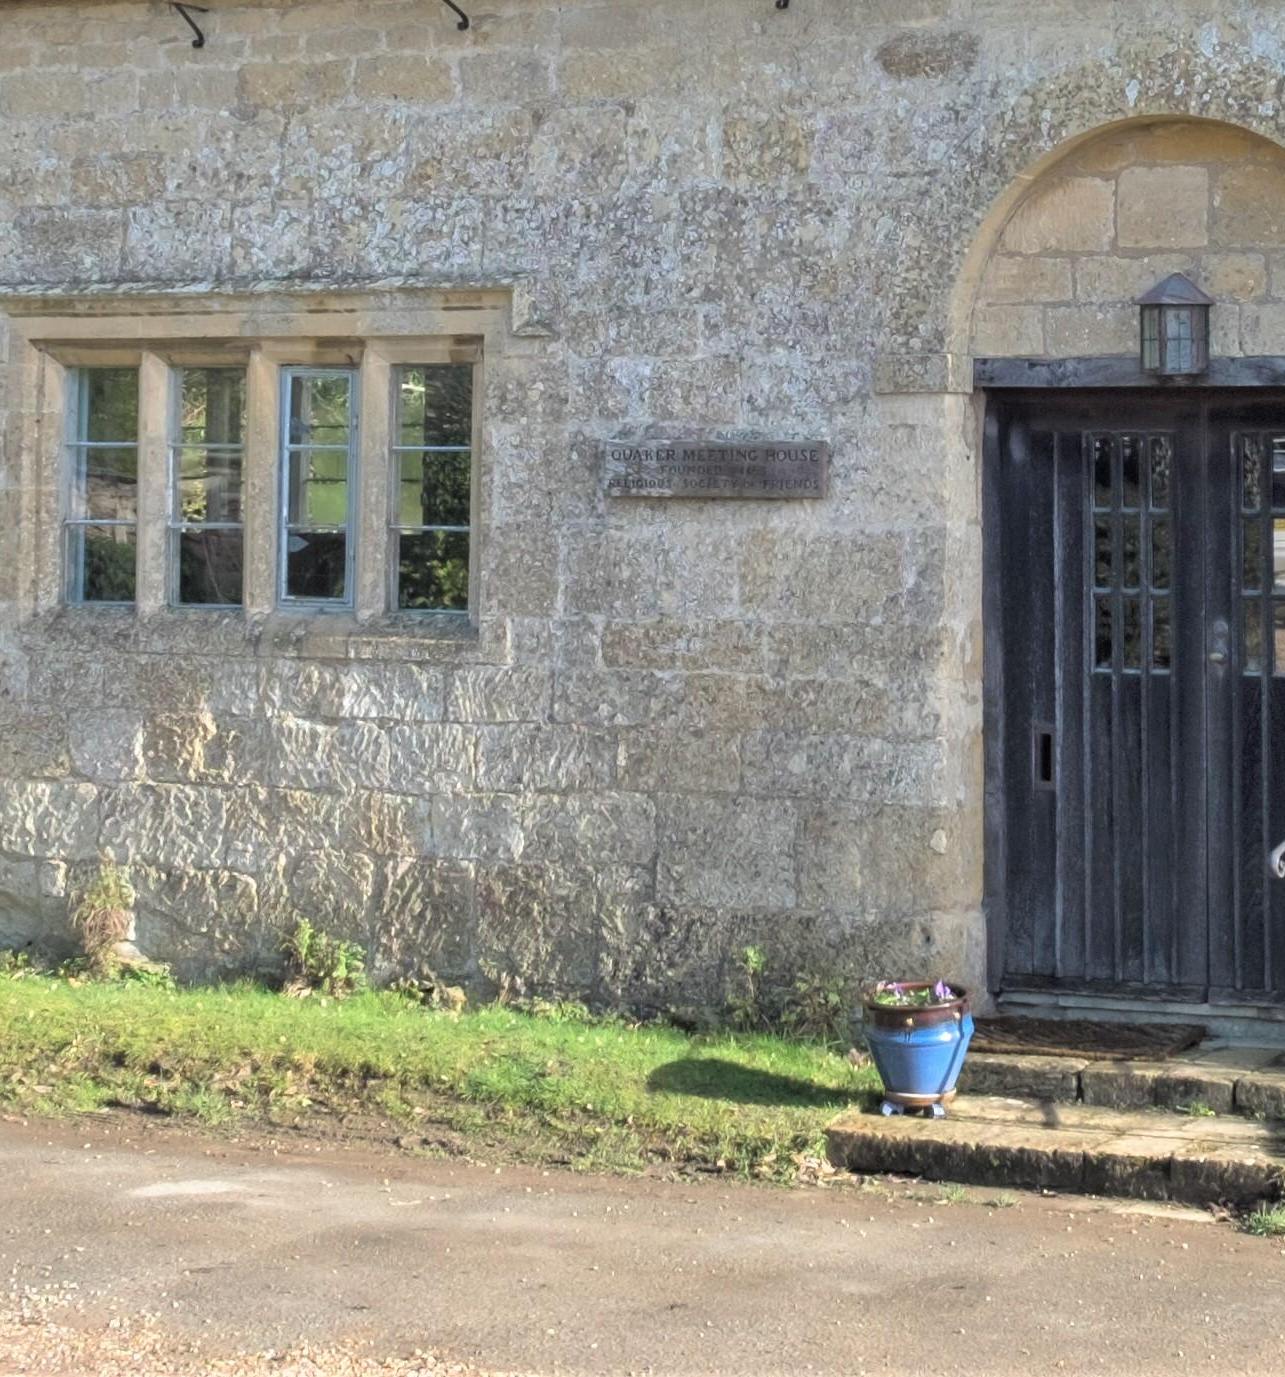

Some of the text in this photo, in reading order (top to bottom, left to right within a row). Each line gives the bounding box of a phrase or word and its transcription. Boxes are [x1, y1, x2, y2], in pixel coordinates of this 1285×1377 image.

[611, 448, 819, 463] QUAKER MEETING HOUSE
[660, 464, 722, 477] FOUNDED
[608, 478, 672, 490] RELIGIOUS
[683, 478, 738, 490] SOCIETY
[763, 478, 821, 491] FRIENDS
